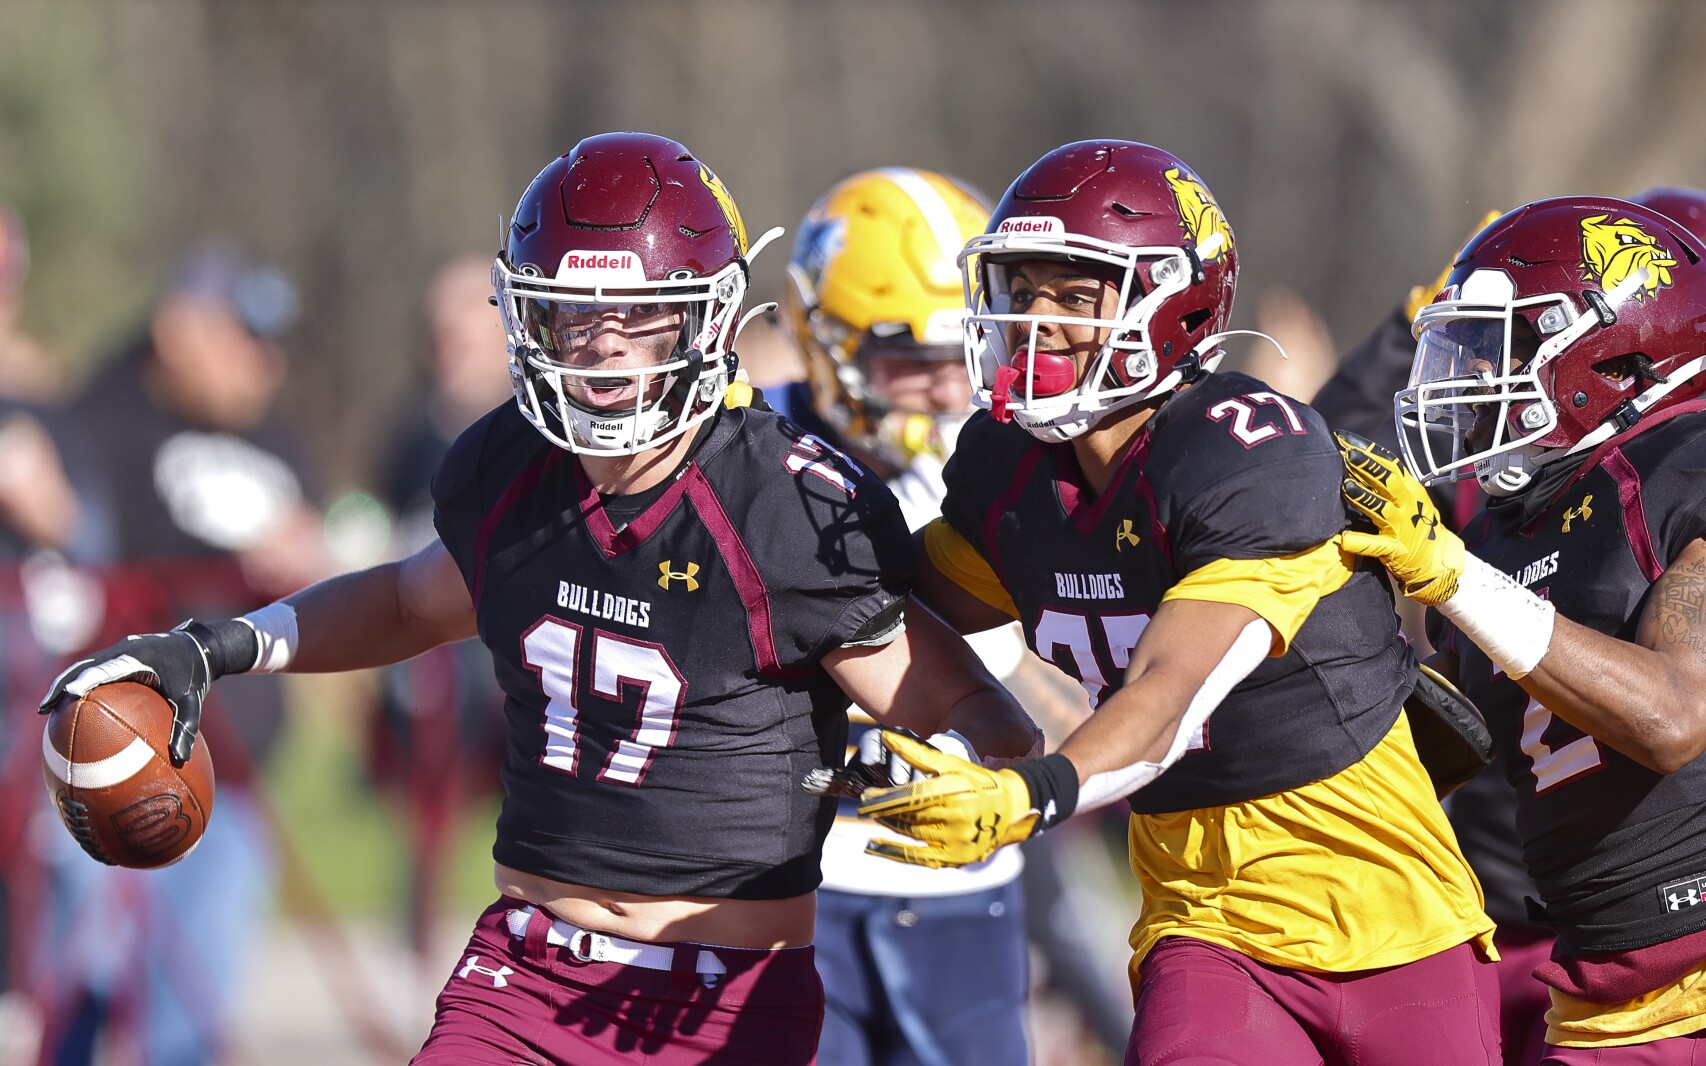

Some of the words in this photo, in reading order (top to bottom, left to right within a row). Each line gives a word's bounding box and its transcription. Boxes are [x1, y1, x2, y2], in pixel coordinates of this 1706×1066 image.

[1000, 221, 1053, 233] Riddell
[567, 255, 632, 269] Riddell
[590, 420, 623, 431] Riddell
[1026, 419, 1056, 429] Riddell
[1206, 391, 1307, 449] 27
[1509, 550, 1560, 588] LDOGS
[1054, 572, 1125, 600] BULLDOGS
[556, 580, 651, 629] BULLDOGS
[519, 613, 690, 789] 17
